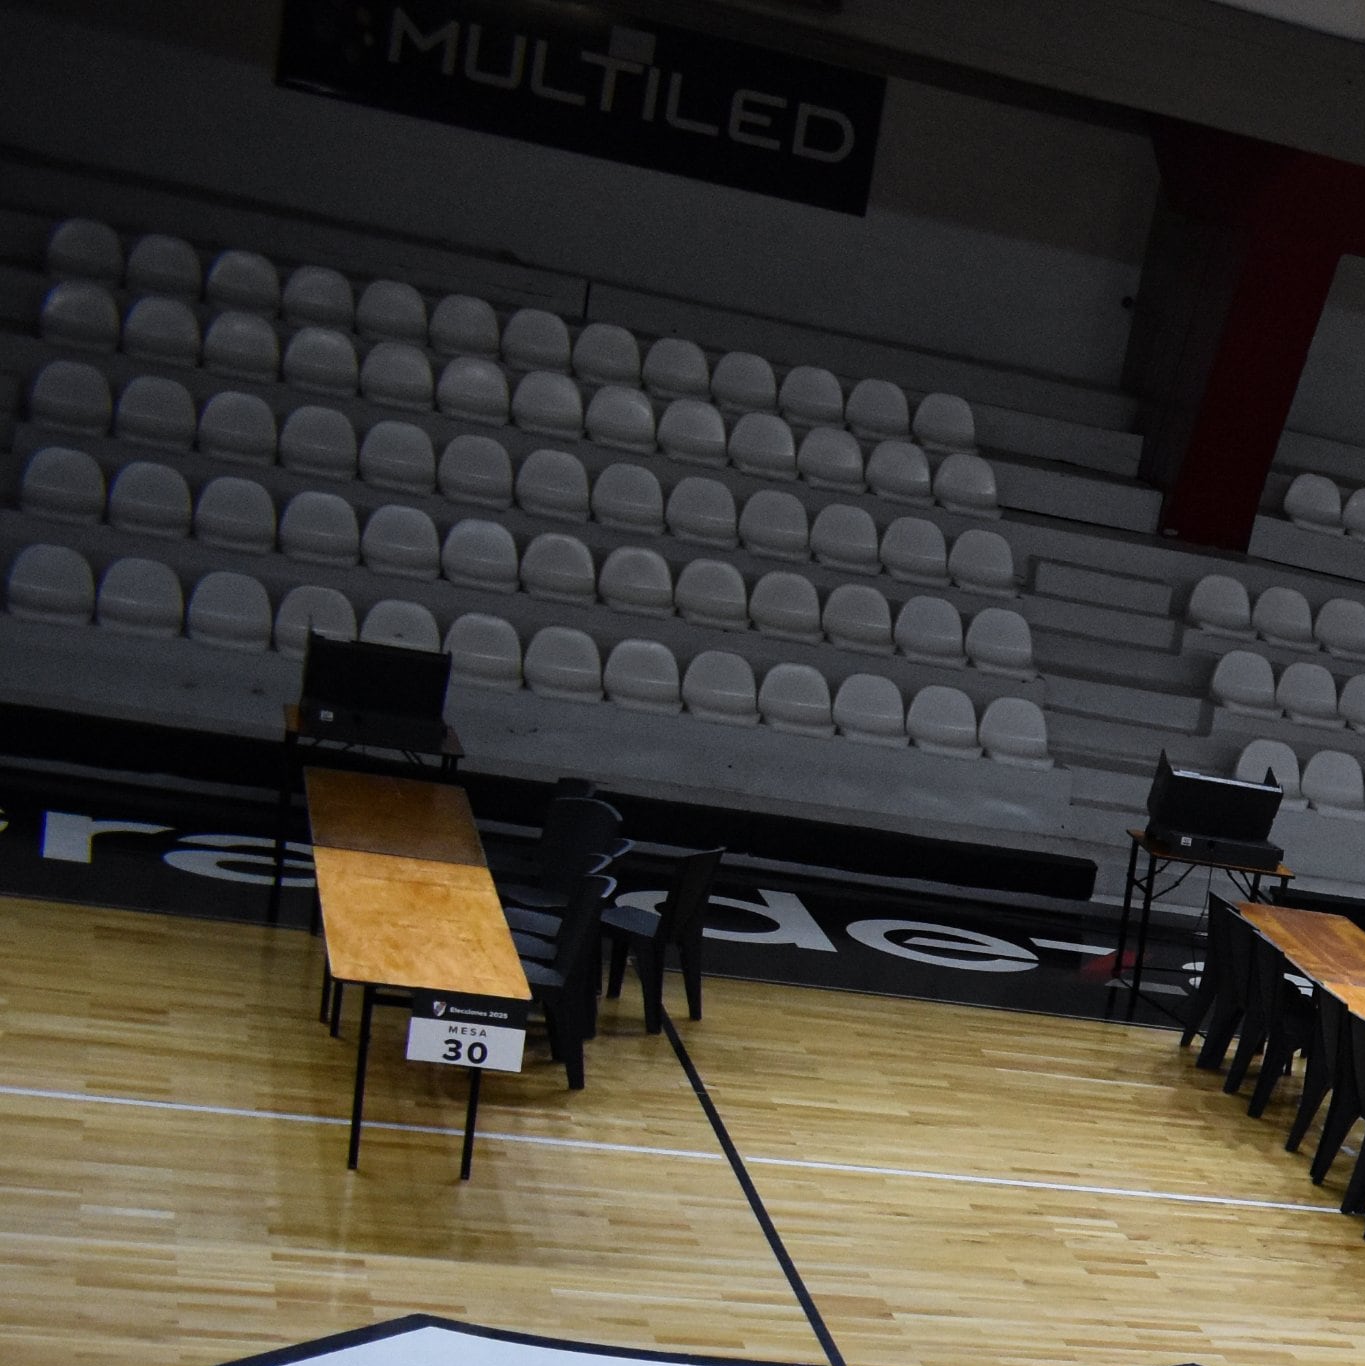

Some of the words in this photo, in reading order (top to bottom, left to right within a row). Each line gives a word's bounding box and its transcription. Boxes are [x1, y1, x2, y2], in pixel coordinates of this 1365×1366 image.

[388, 6, 856, 165] MULTILED
[449, 1006, 488, 1018] Elecciones
[488, 1011, 509, 1020] 2025
[448, 1025, 488, 1038] MESA
[442, 1038, 488, 1065] 30
